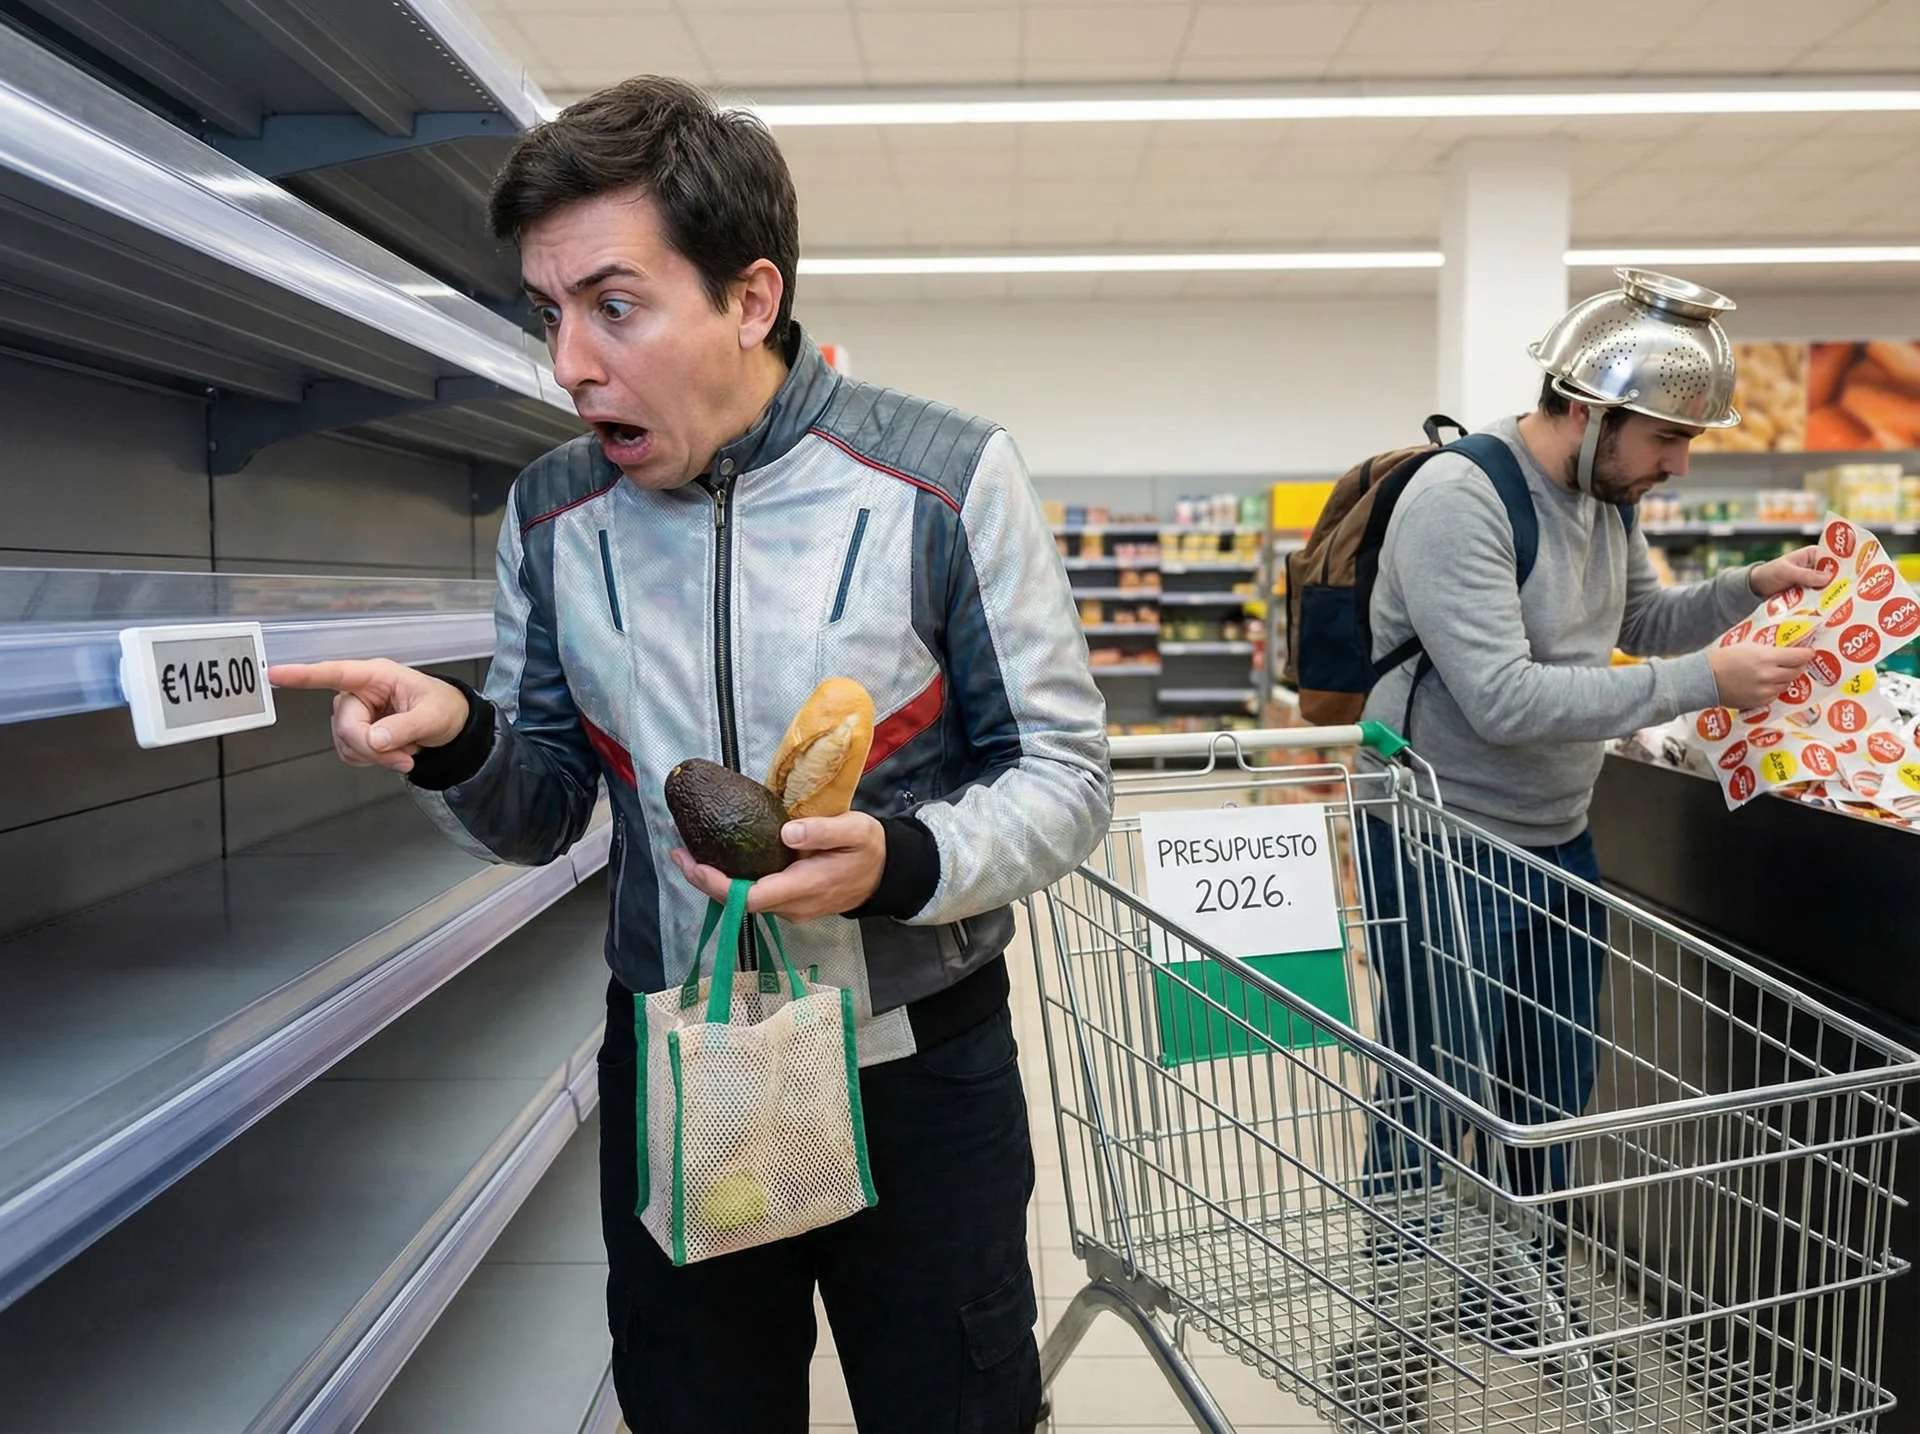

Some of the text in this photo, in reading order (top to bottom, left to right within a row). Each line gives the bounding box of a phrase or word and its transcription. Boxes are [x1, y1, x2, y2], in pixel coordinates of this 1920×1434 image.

[1883, 602, 1916, 629] 20%
[1843, 629, 1874, 655] 20%
[162, 657, 255, 704] €145.00
[1158, 834, 1317, 867] PRESUPUESTO
[1195, 875, 1292, 913] 2026.
